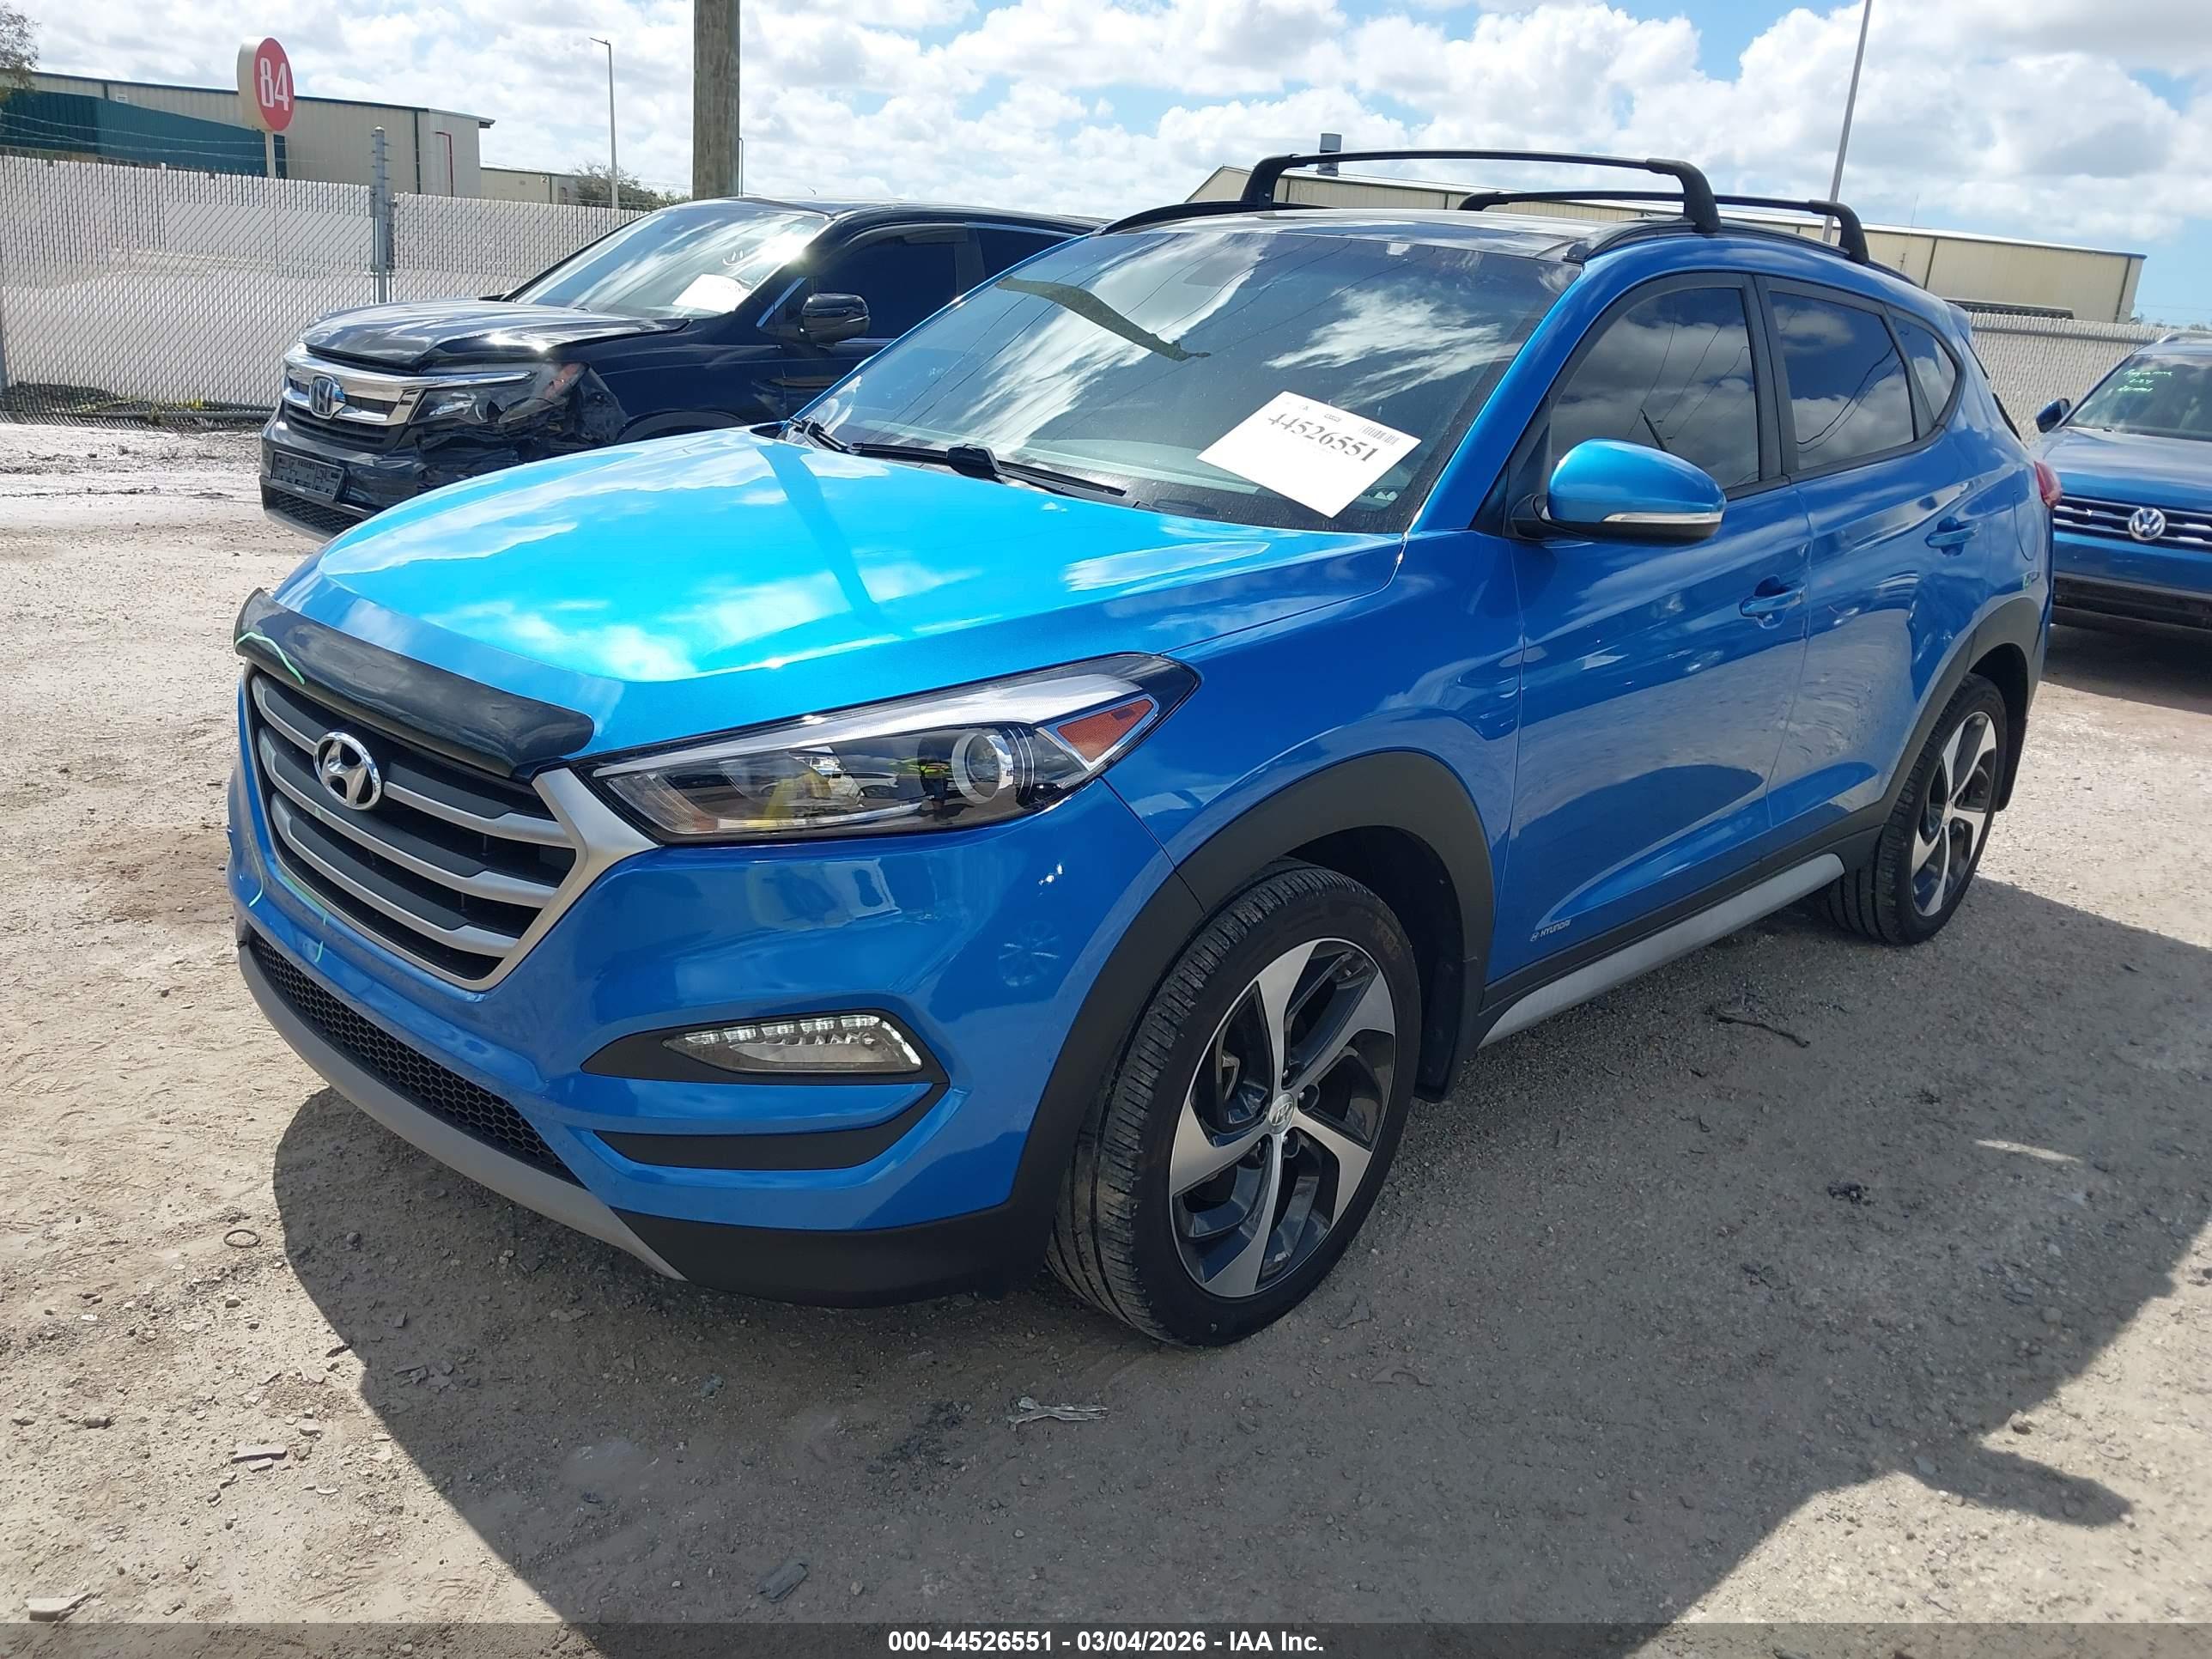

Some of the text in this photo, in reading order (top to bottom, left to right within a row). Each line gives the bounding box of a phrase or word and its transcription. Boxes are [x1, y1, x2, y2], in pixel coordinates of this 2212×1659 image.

[259, 57, 289, 111] 84
[1268, 413, 1379, 462] 44526551
[1540, 919, 1572, 938] HYUNDAI
